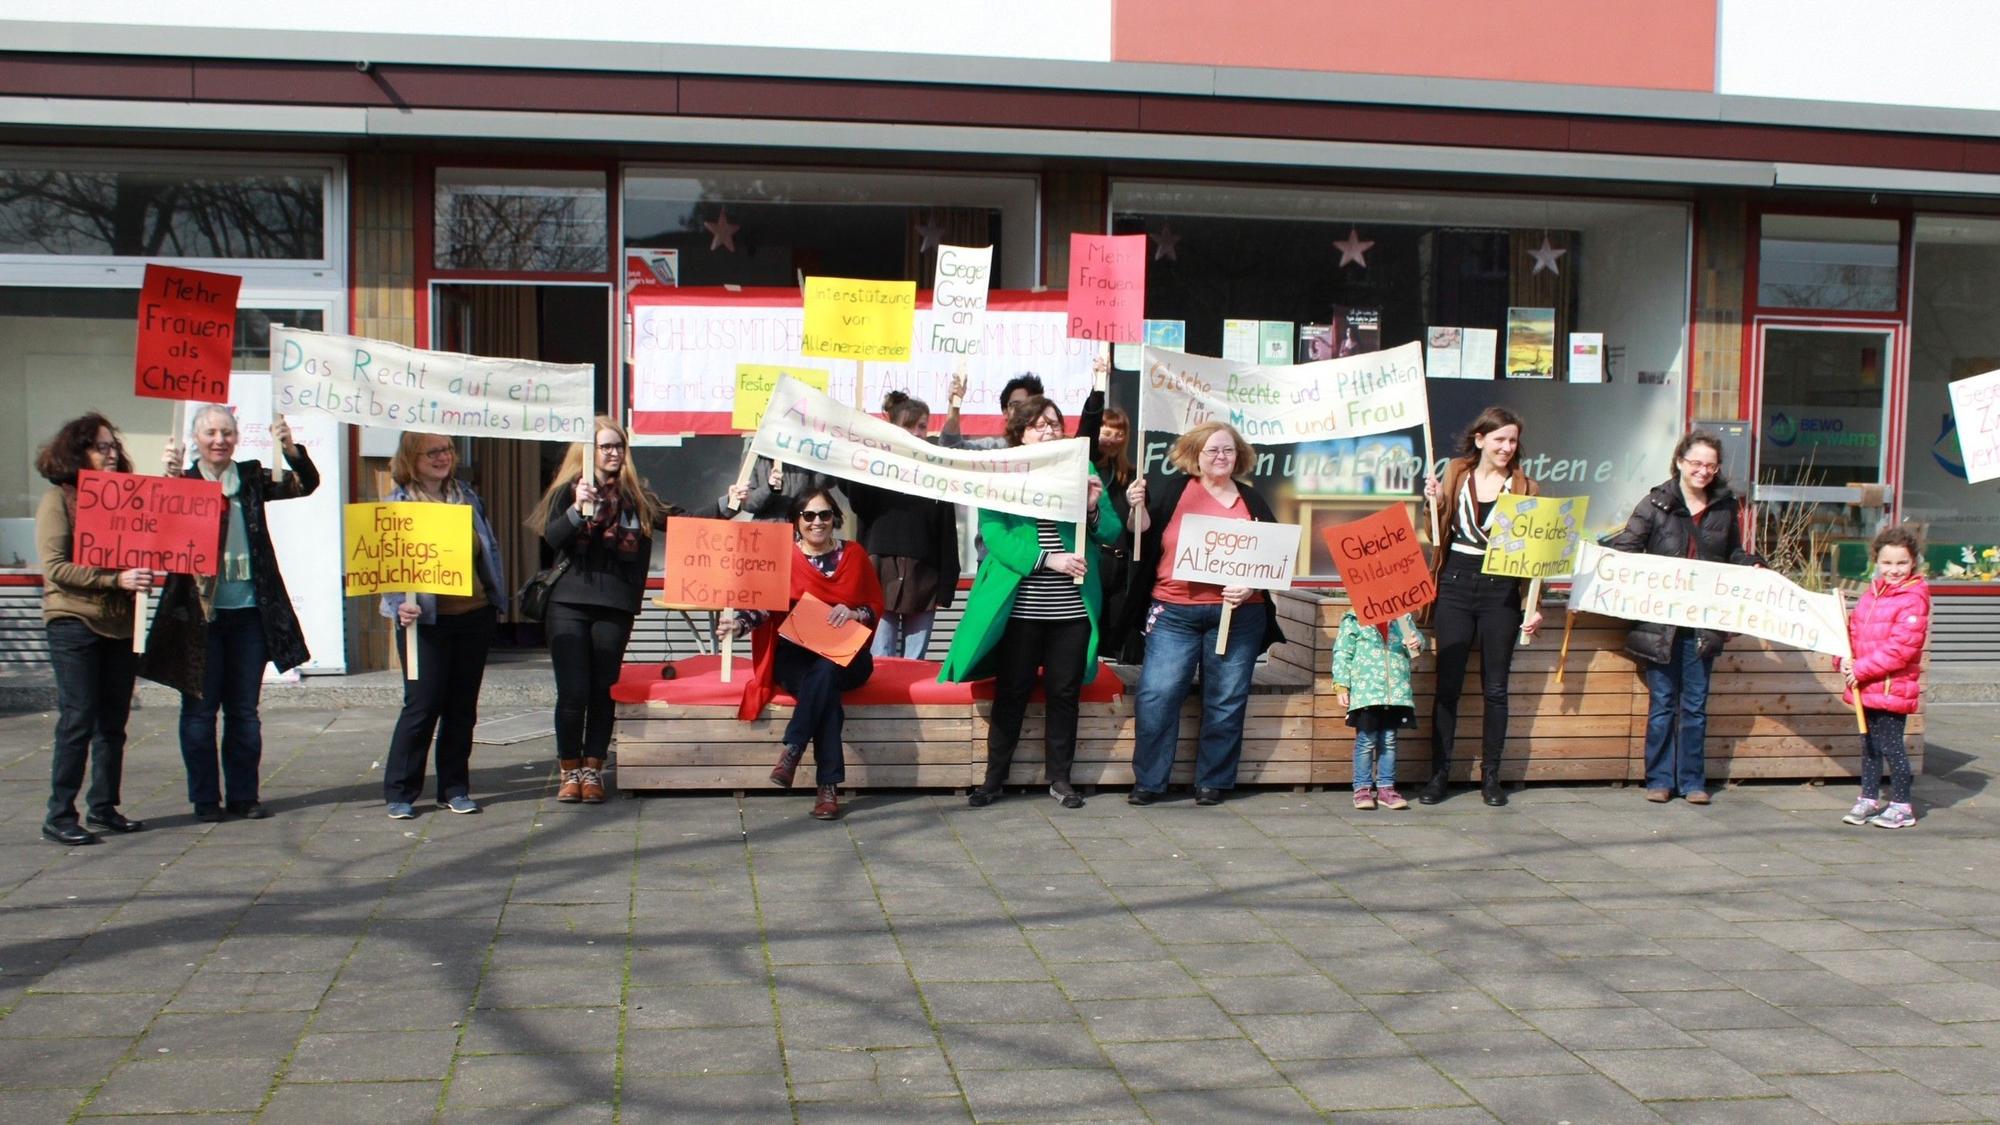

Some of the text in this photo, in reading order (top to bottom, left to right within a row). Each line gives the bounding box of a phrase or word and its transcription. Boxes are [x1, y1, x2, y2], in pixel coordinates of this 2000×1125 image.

[1088, 242, 1131, 264] Mehr
[163, 277, 222, 304] Mehr
[1080, 266, 1134, 290] Frauen
[1095, 296, 1106, 307] in
[144, 303, 231, 338] Frauen
[952, 311, 974, 326] an
[1071, 316, 1137, 342] Politik
[168, 340, 199, 359] als
[142, 365, 225, 399] Chefin
[281, 339, 550, 403] Das Recht auf ein
[1225, 372, 1281, 406] Rechte
[1290, 378, 1321, 404] und
[1336, 362, 1418, 399] Pflichten
[522, 404, 586, 433] Leben
[1184, 397, 1405, 436] für Mann und Frau
[775, 431, 1065, 512] und Ganztagsschulen
[79, 476, 218, 518] 50% Frauen
[109, 513, 158, 533] in die
[373, 506, 414, 533] Faire
[1511, 513, 1569, 541] Gleiches
[695, 526, 763, 553] Recht
[1204, 529, 1259, 556] gegen
[1341, 520, 1408, 561] Gleiche
[683, 553, 776, 577] am eigenen
[1347, 551, 1421, 585] Bildungs-
[1486, 547, 1571, 577] Einkommen
[681, 577, 763, 608] Körper
[1596, 552, 1808, 612] Gerecht bezahlte
[1362, 580, 1433, 620] chancen
[1593, 583, 1819, 649] Kindererziehung
